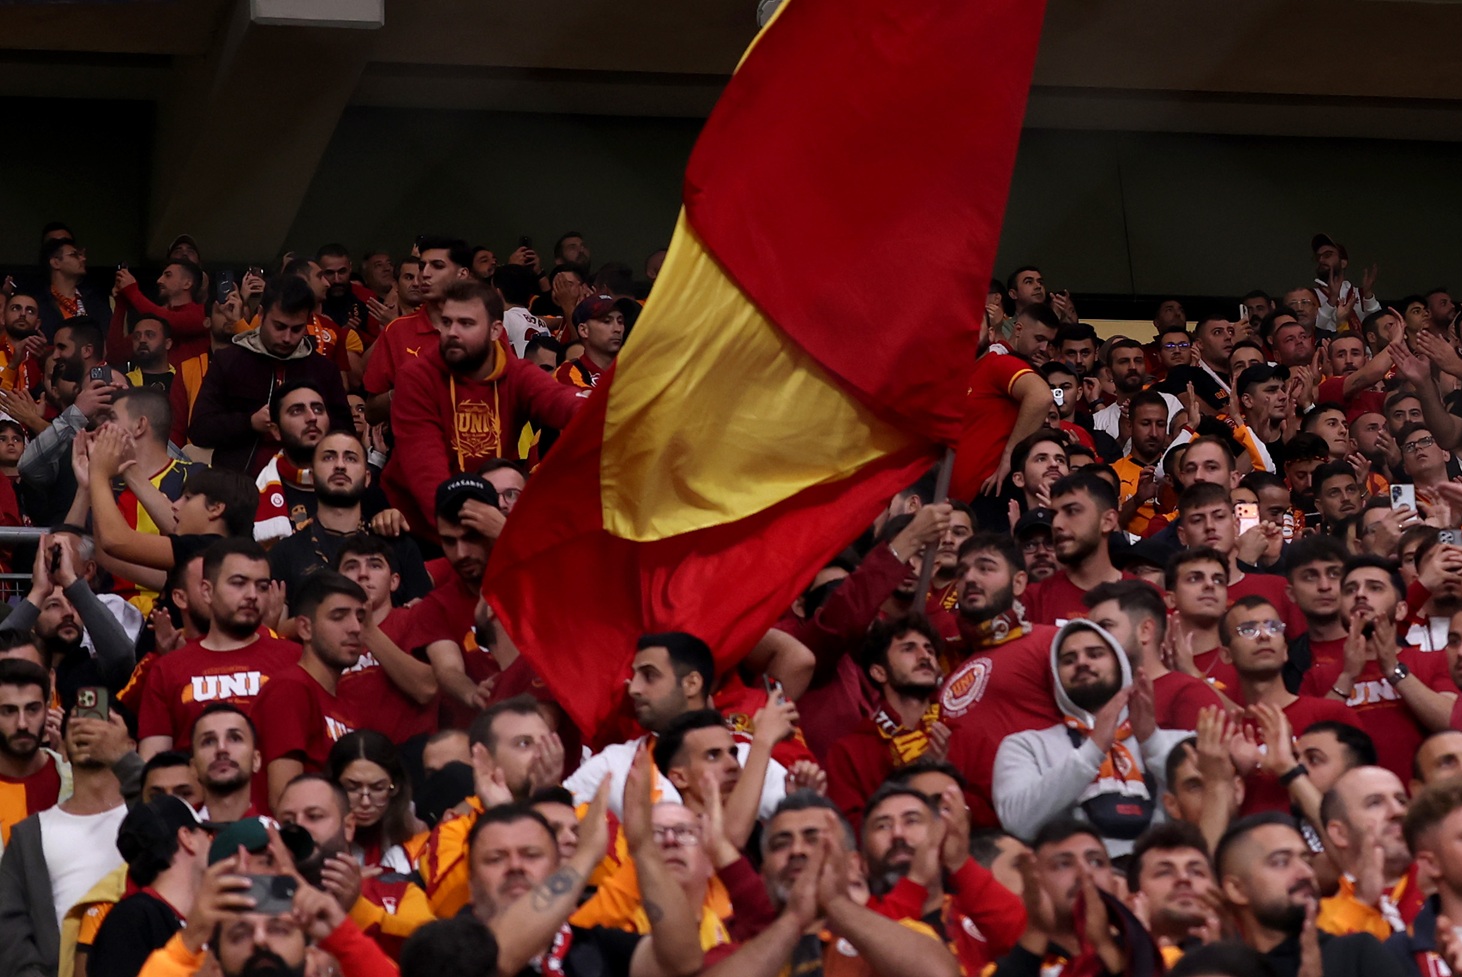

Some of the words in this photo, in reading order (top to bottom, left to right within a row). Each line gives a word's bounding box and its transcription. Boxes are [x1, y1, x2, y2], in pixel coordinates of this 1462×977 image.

[458, 412, 490, 433] UNI
[191, 671, 261, 703] UNI
[950, 669, 976, 698] UNI
